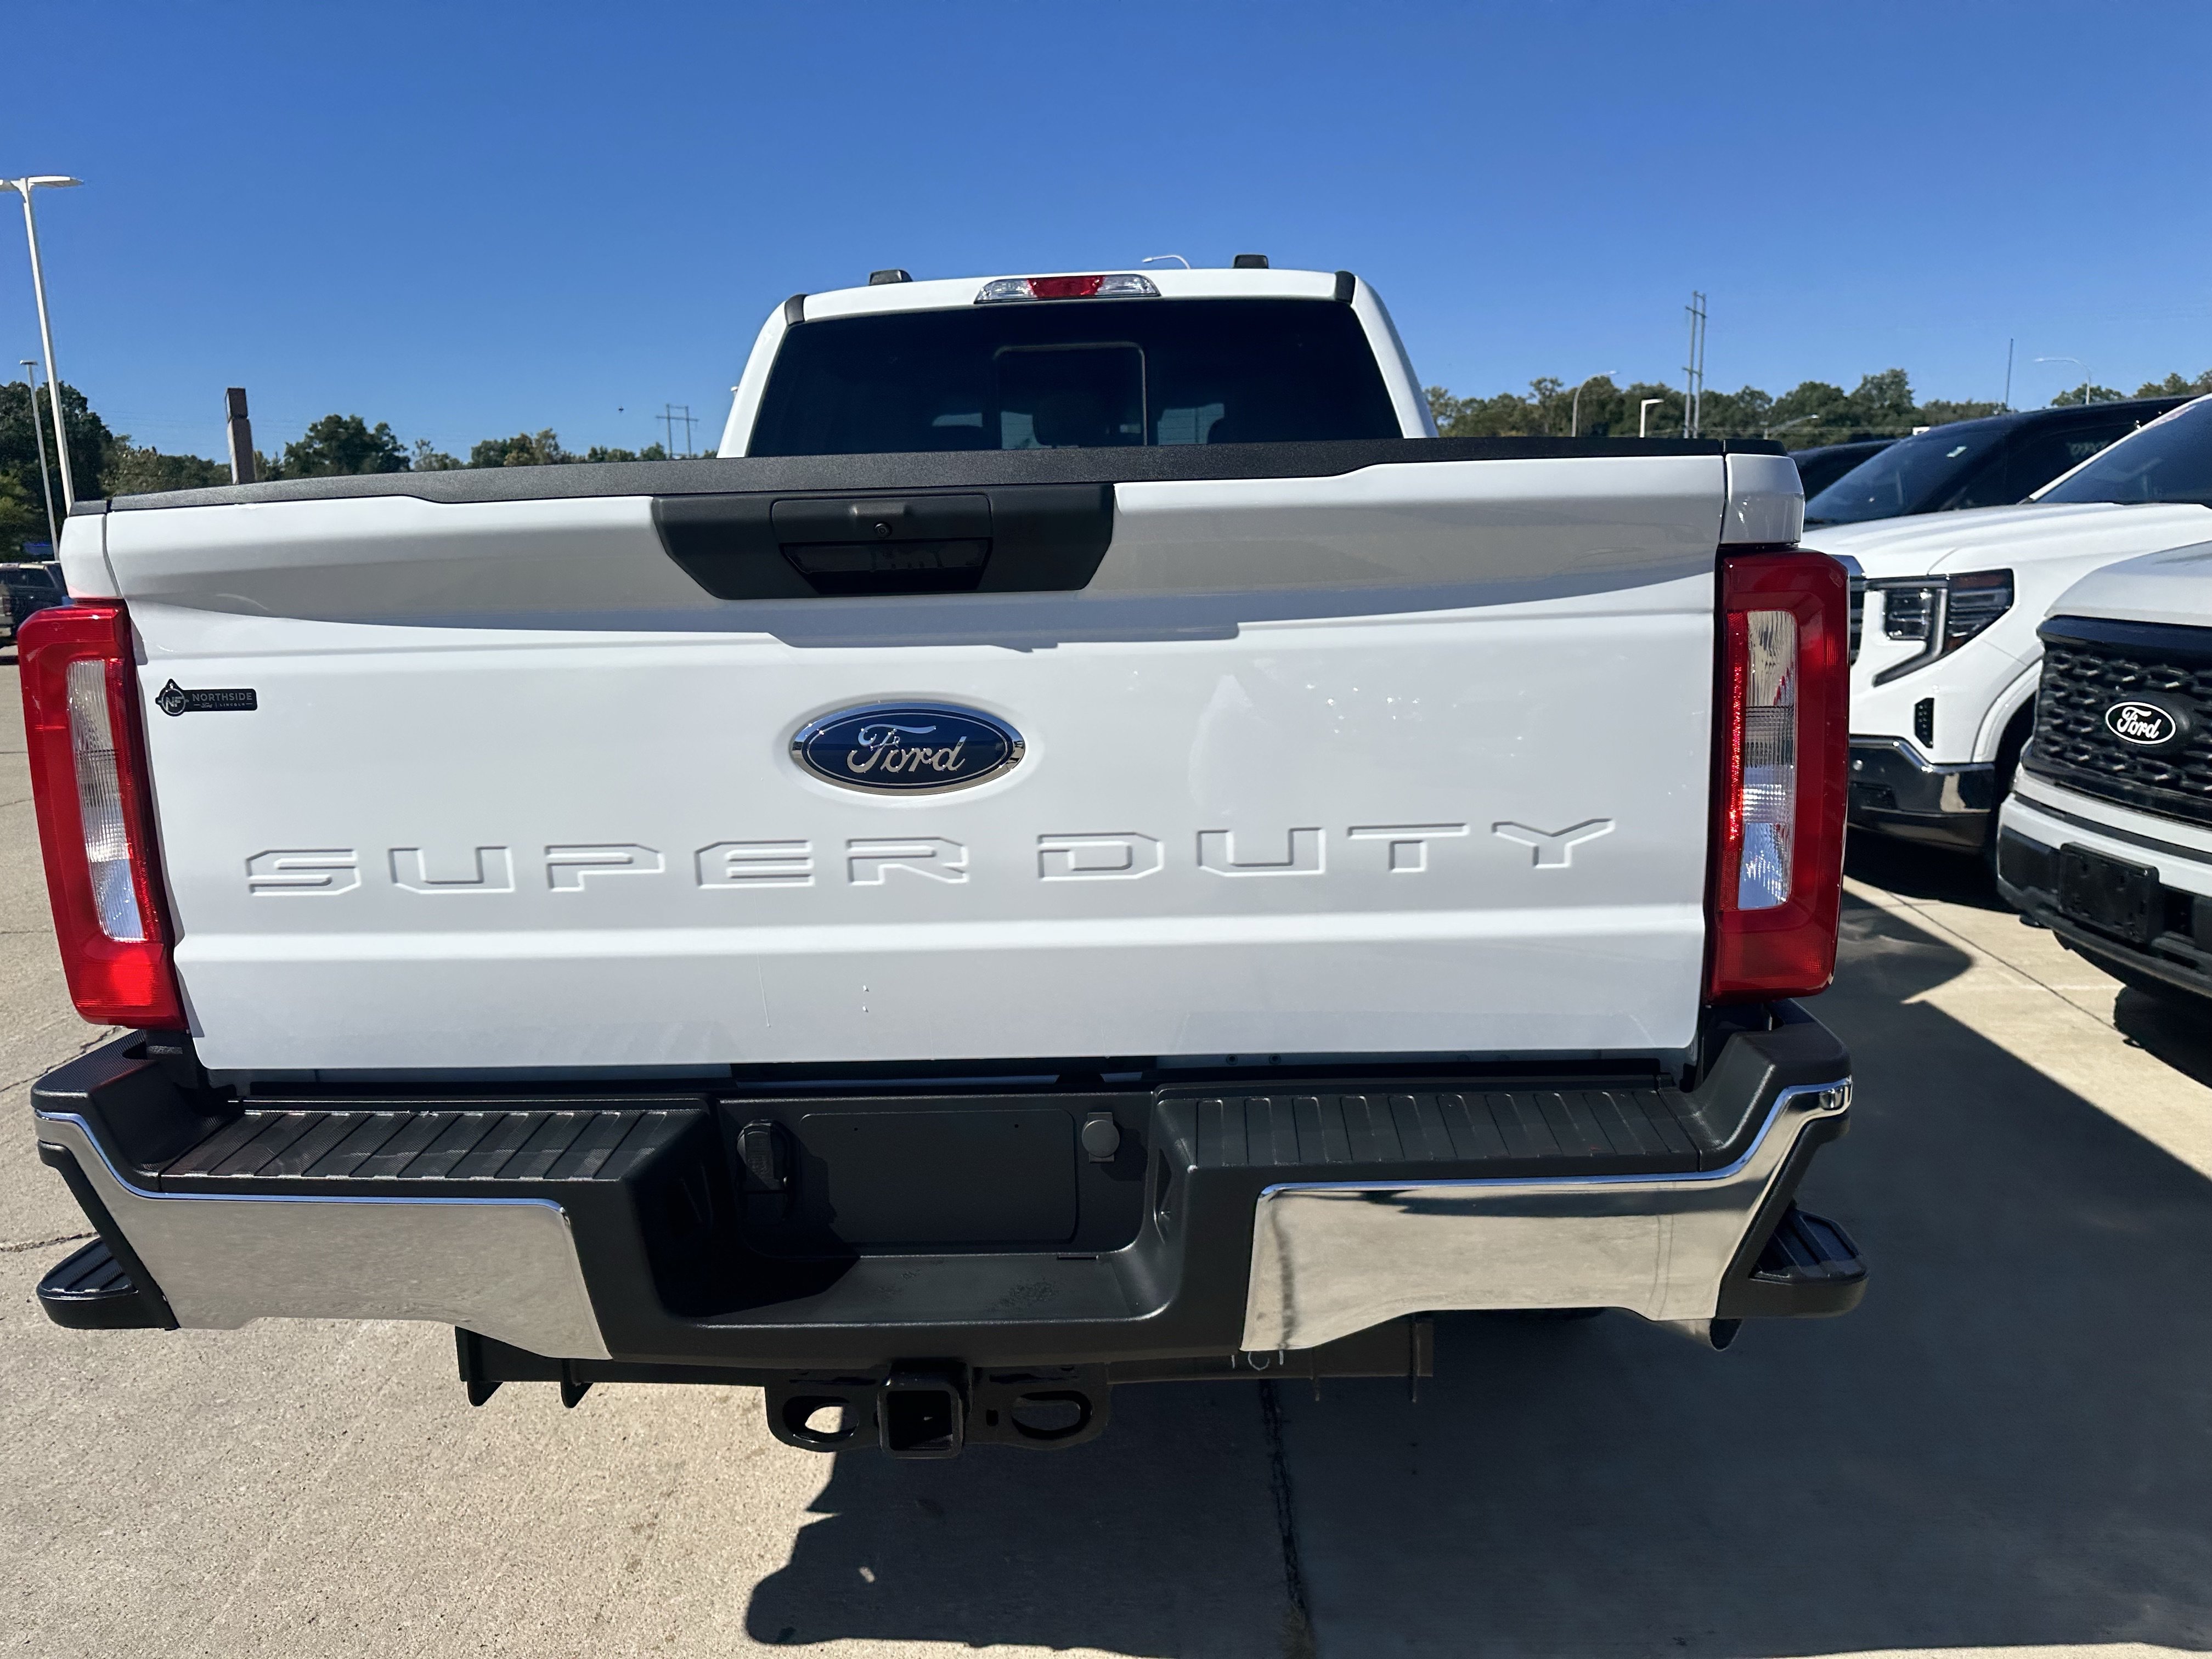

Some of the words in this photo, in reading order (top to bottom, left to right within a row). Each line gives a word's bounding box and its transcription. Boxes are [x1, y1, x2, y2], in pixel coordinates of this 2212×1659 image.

[192, 692, 253, 702] NORTHSIDE
[2117, 706, 2162, 739] Ford
[847, 724, 967, 774] Ford
[246, 836, 969, 896] SUPER
[1037, 817, 1616, 882] DUTY
